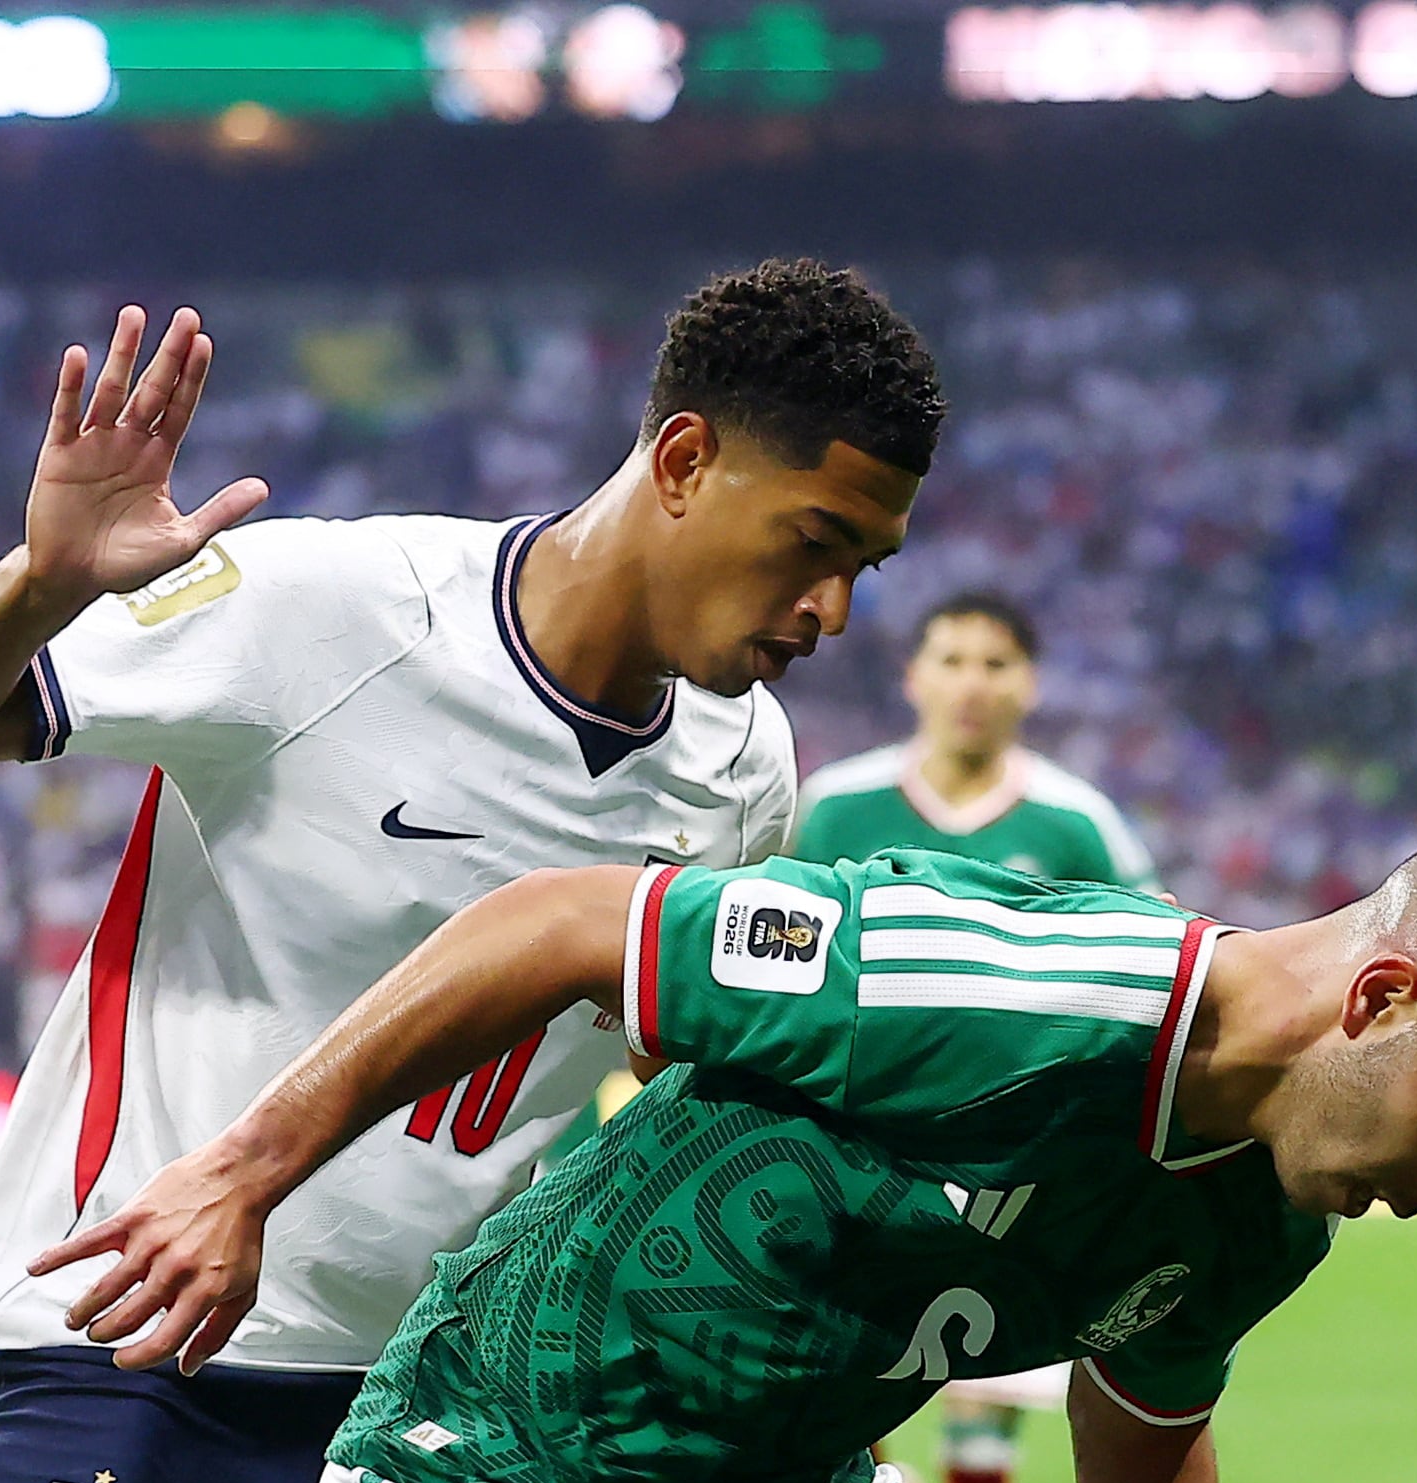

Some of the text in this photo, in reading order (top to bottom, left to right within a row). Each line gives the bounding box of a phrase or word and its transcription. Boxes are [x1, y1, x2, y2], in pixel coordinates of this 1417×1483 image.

[723, 903, 740, 955] 2026
[736, 905, 749, 956] WORLD CUP
[753, 920, 767, 946] FIFA
